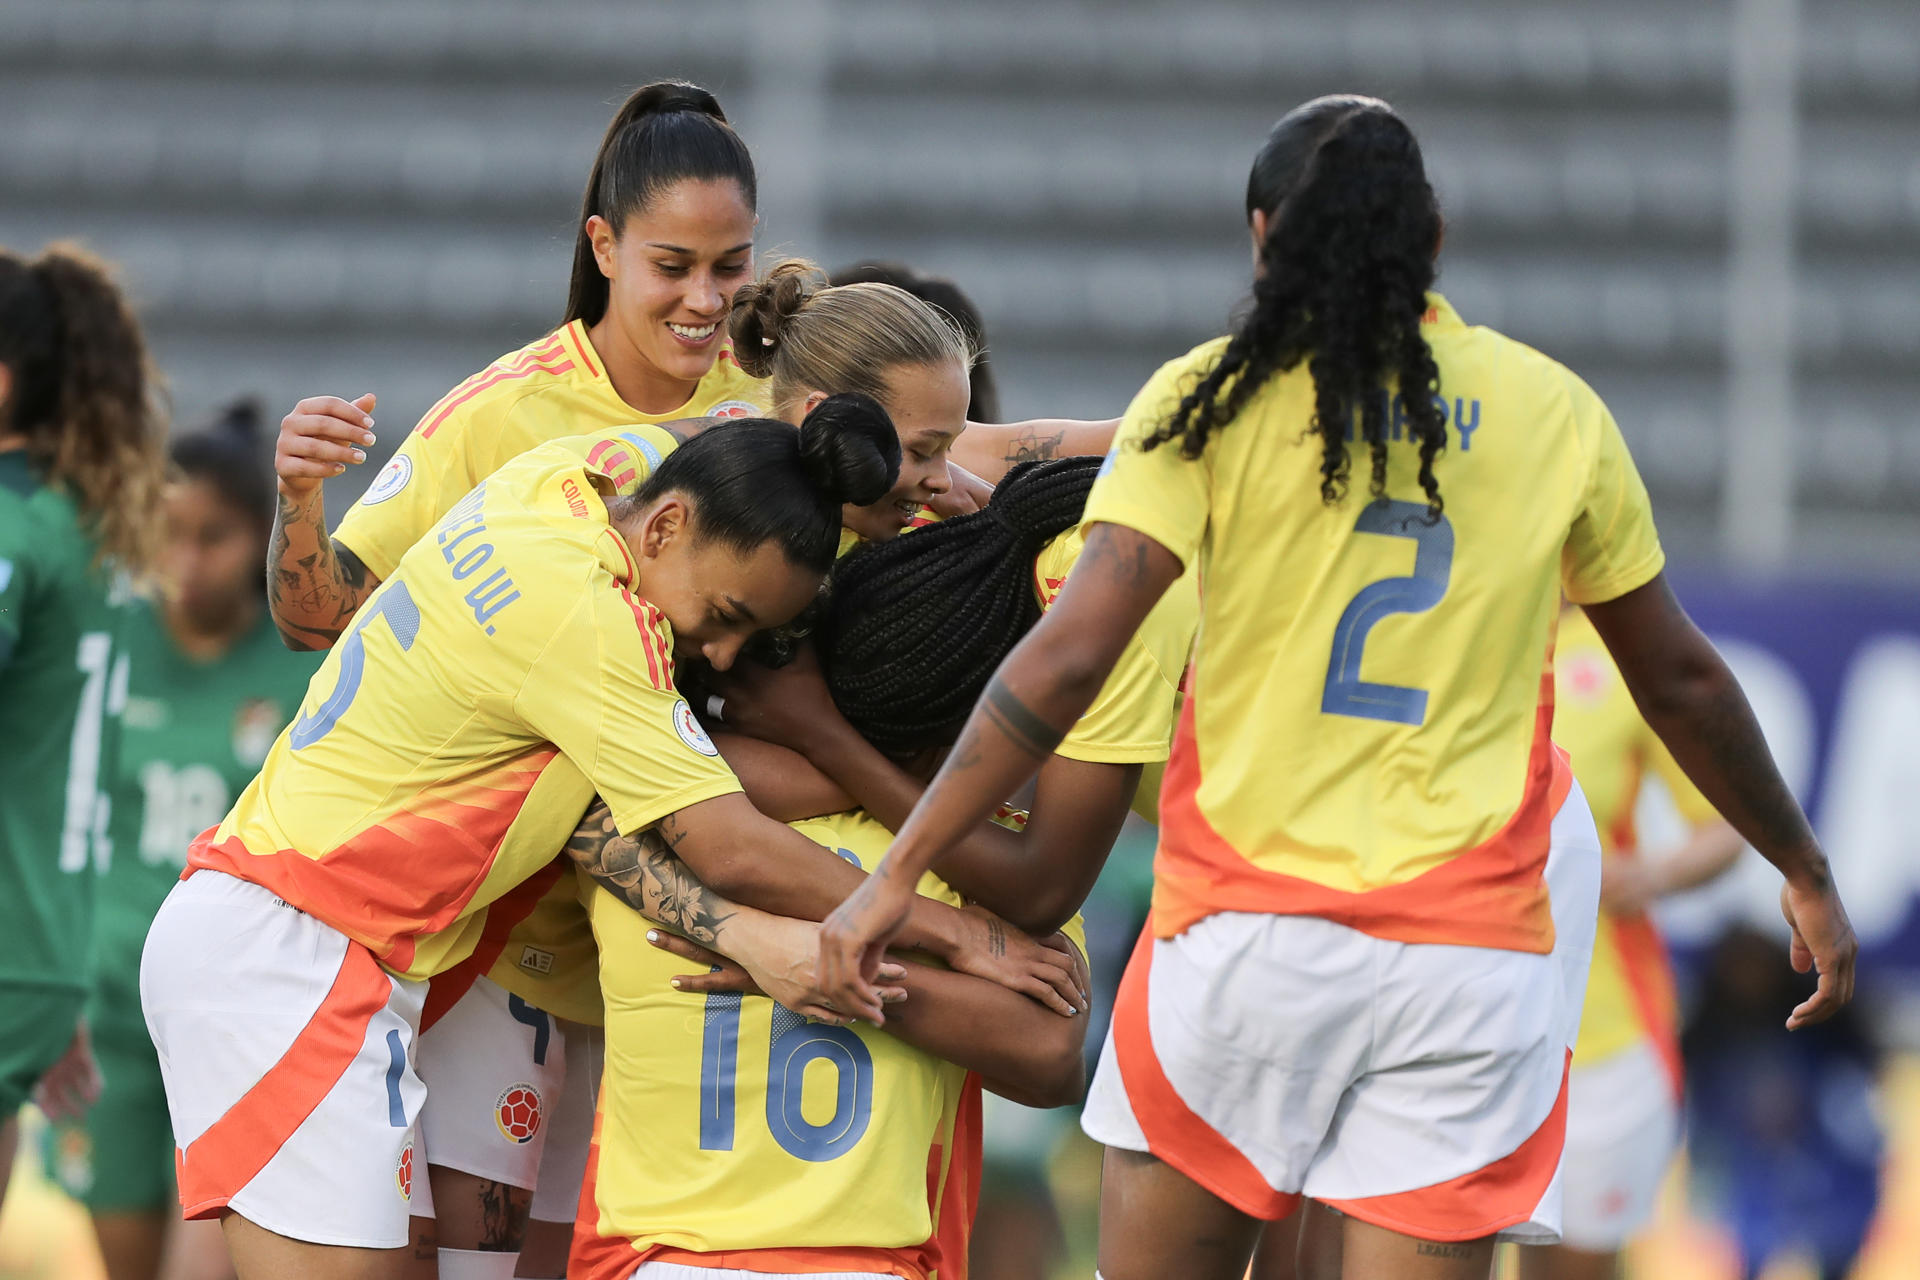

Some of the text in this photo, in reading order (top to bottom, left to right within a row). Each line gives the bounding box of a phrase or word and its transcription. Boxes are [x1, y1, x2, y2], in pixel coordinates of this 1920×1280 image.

[464, 566, 521, 636] W.
[1321, 499, 1455, 726] 2
[700, 964, 874, 1162] 16
